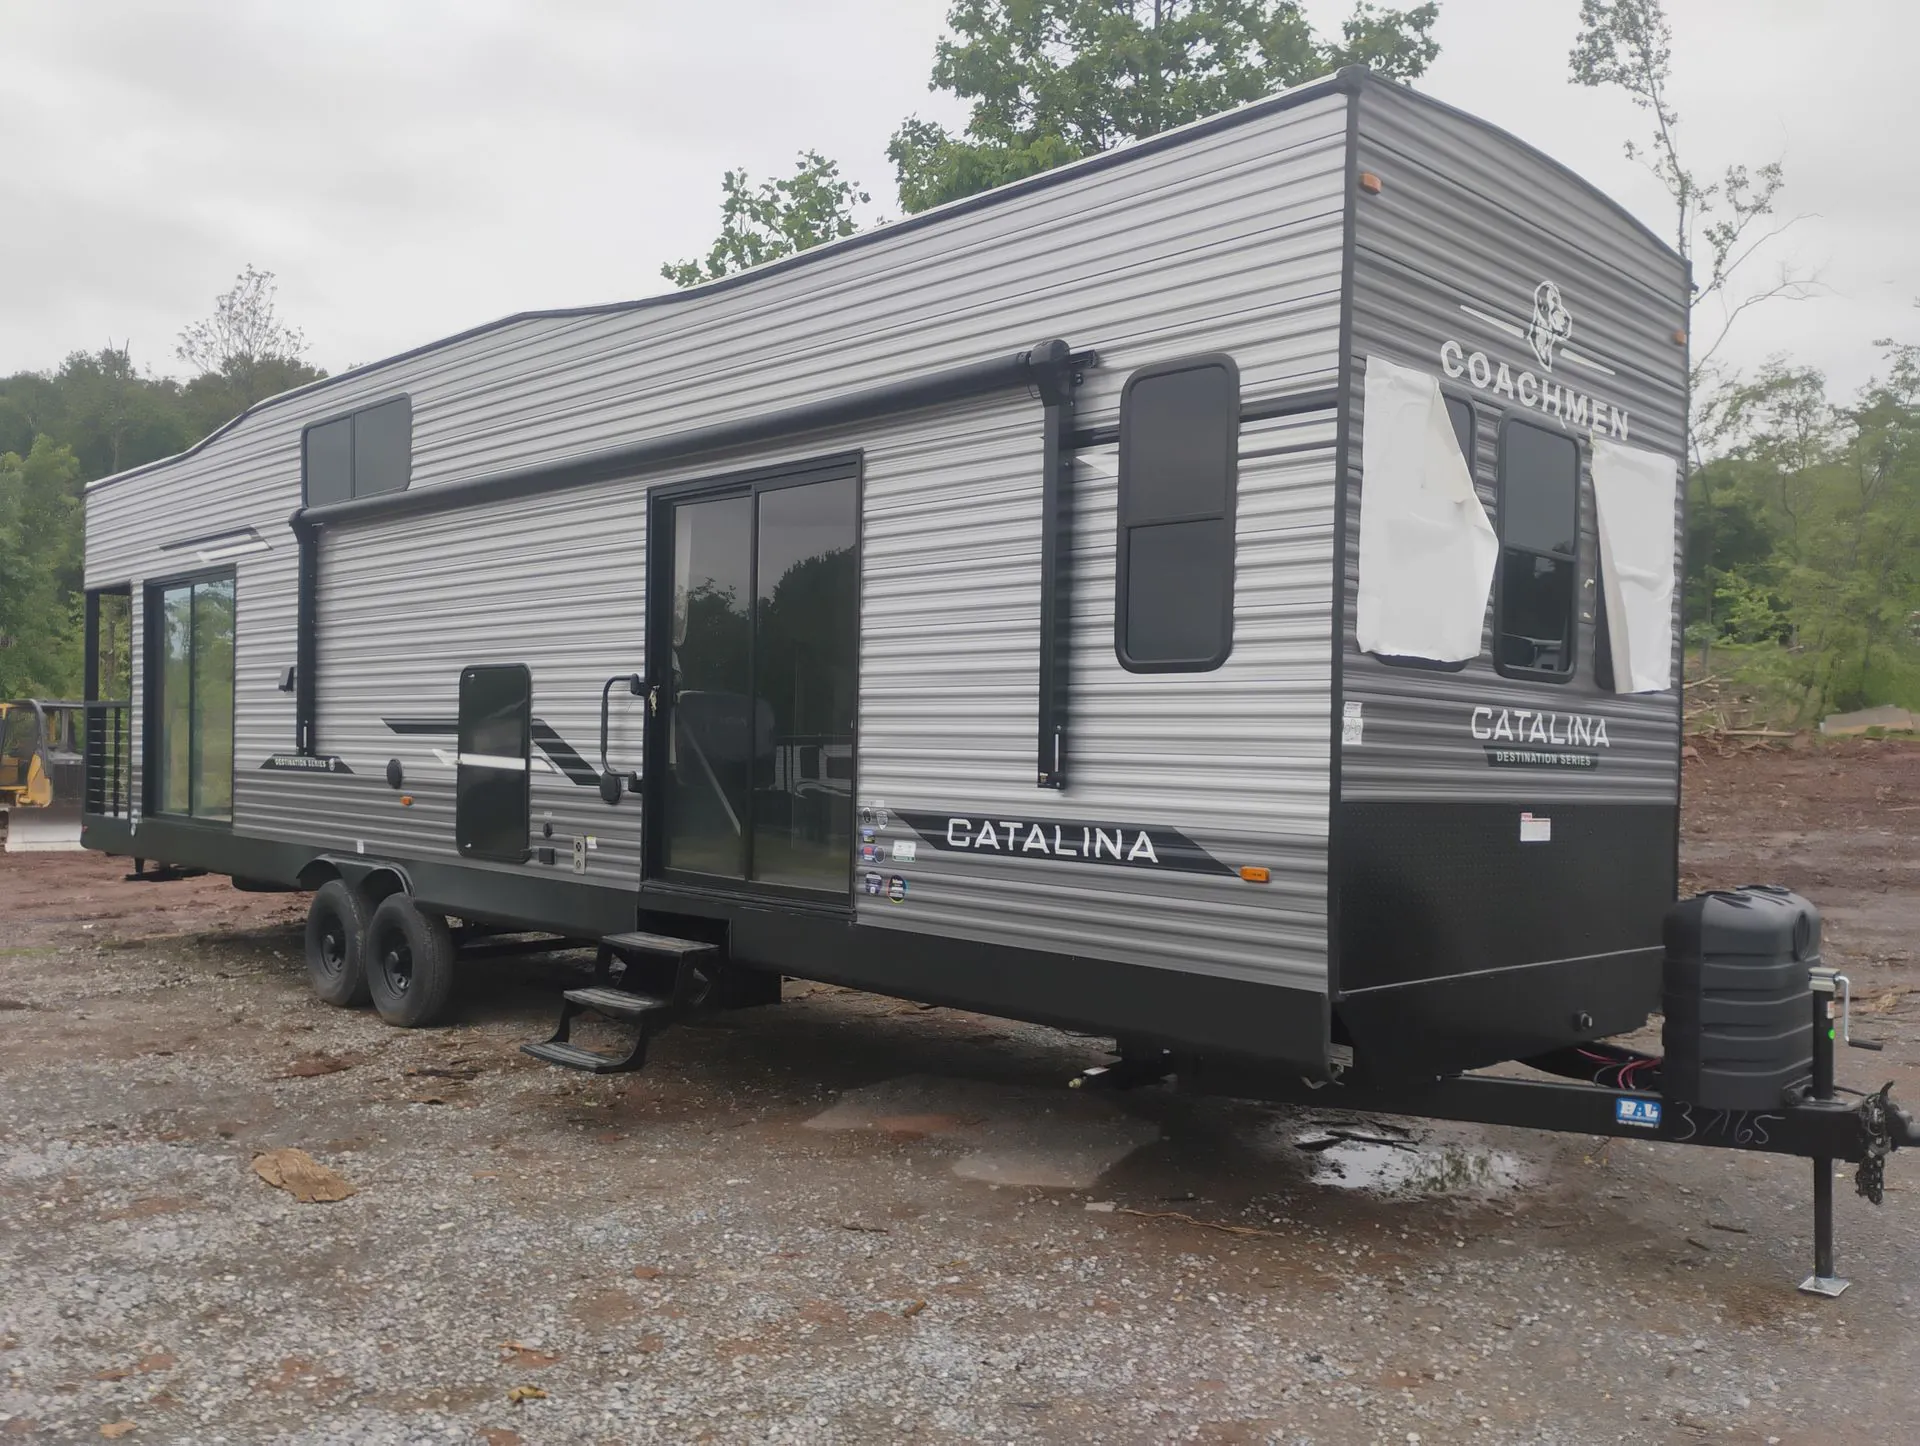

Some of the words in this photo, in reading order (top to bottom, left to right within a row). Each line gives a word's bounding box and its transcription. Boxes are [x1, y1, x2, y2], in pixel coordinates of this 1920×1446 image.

[1441, 340, 1630, 441] COACHMEN
[1471, 706, 1610, 748] CATALINA
[1497, 751, 1558, 765] DESTINATION
[1560, 755, 1592, 766] SERIES
[947, 818, 1160, 864] CATALINA
